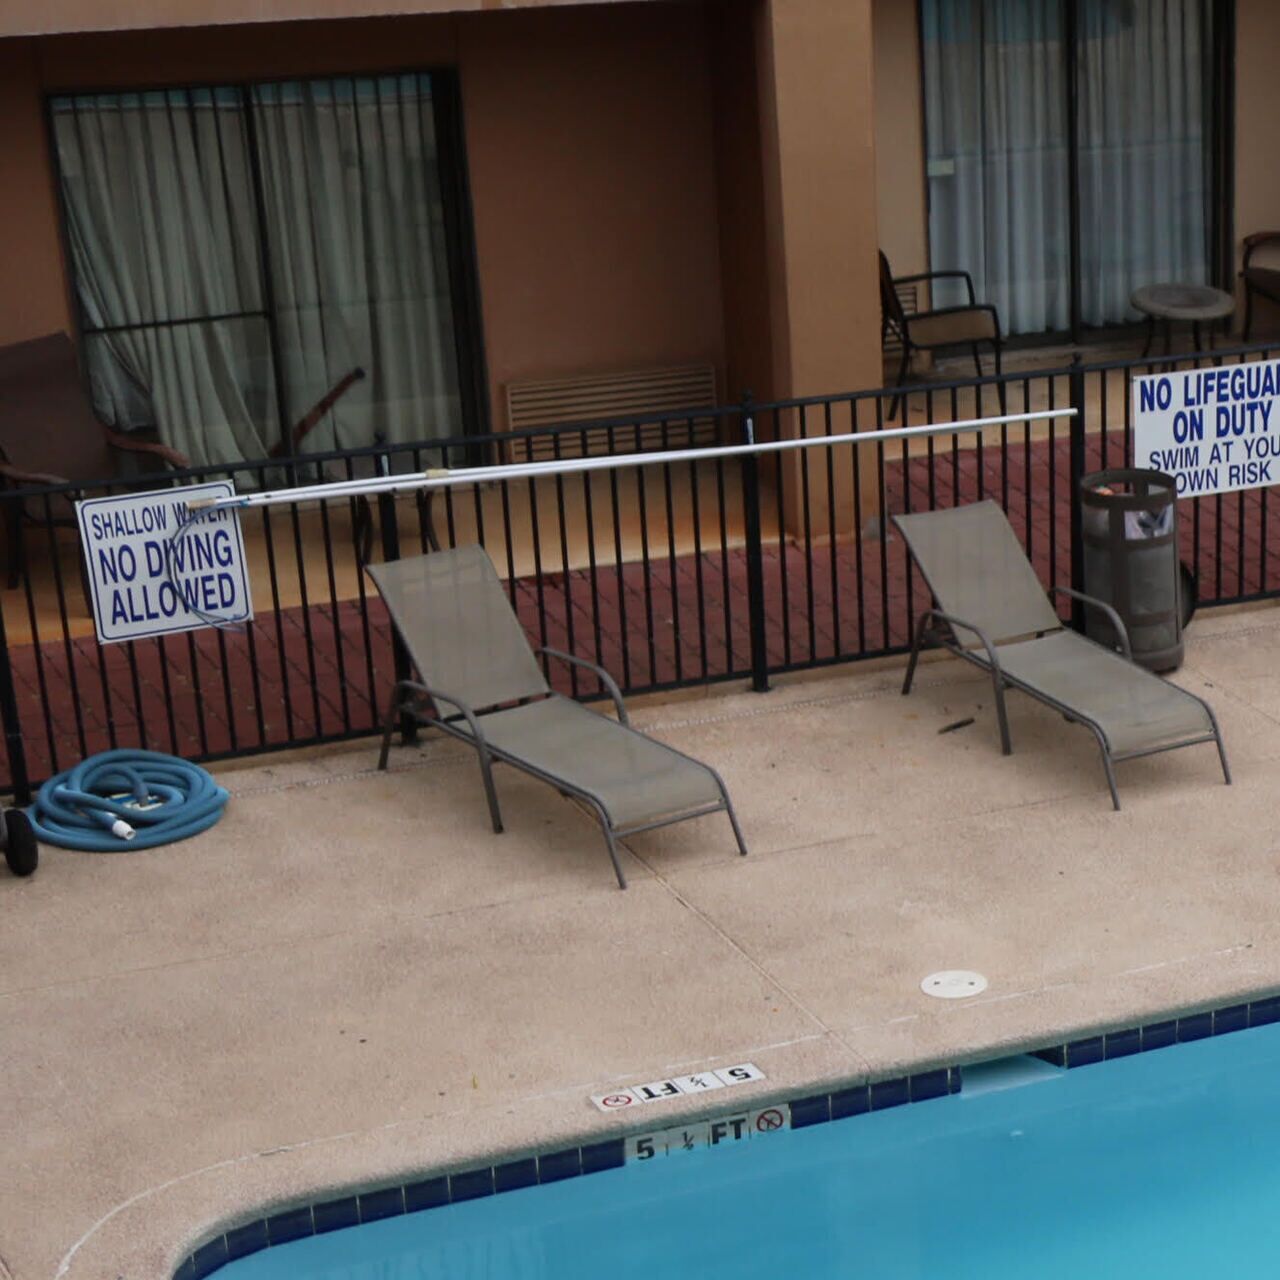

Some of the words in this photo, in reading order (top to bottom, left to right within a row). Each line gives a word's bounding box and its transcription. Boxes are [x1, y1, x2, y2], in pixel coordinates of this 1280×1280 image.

[1140, 377, 1172, 412] NO
[1173, 408, 1203, 444] ON
[1216, 400, 1273, 438] DUTY
[1150, 446, 1200, 472] SWIM
[1209, 441, 1234, 464] AT
[1175, 468, 1218, 493] OWN
[1229, 460, 1272, 486] RISK
[91, 504, 166, 540] SHALLOW
[98, 544, 137, 585] NO
[145, 529, 234, 578] DIVING
[112, 573, 236, 625] ALLOWED
[641, 1082, 679, 1100] FT
[729, 1067, 750, 1081] 5
[636, 1137, 655, 1161] 5
[711, 1118, 746, 1145] FT
